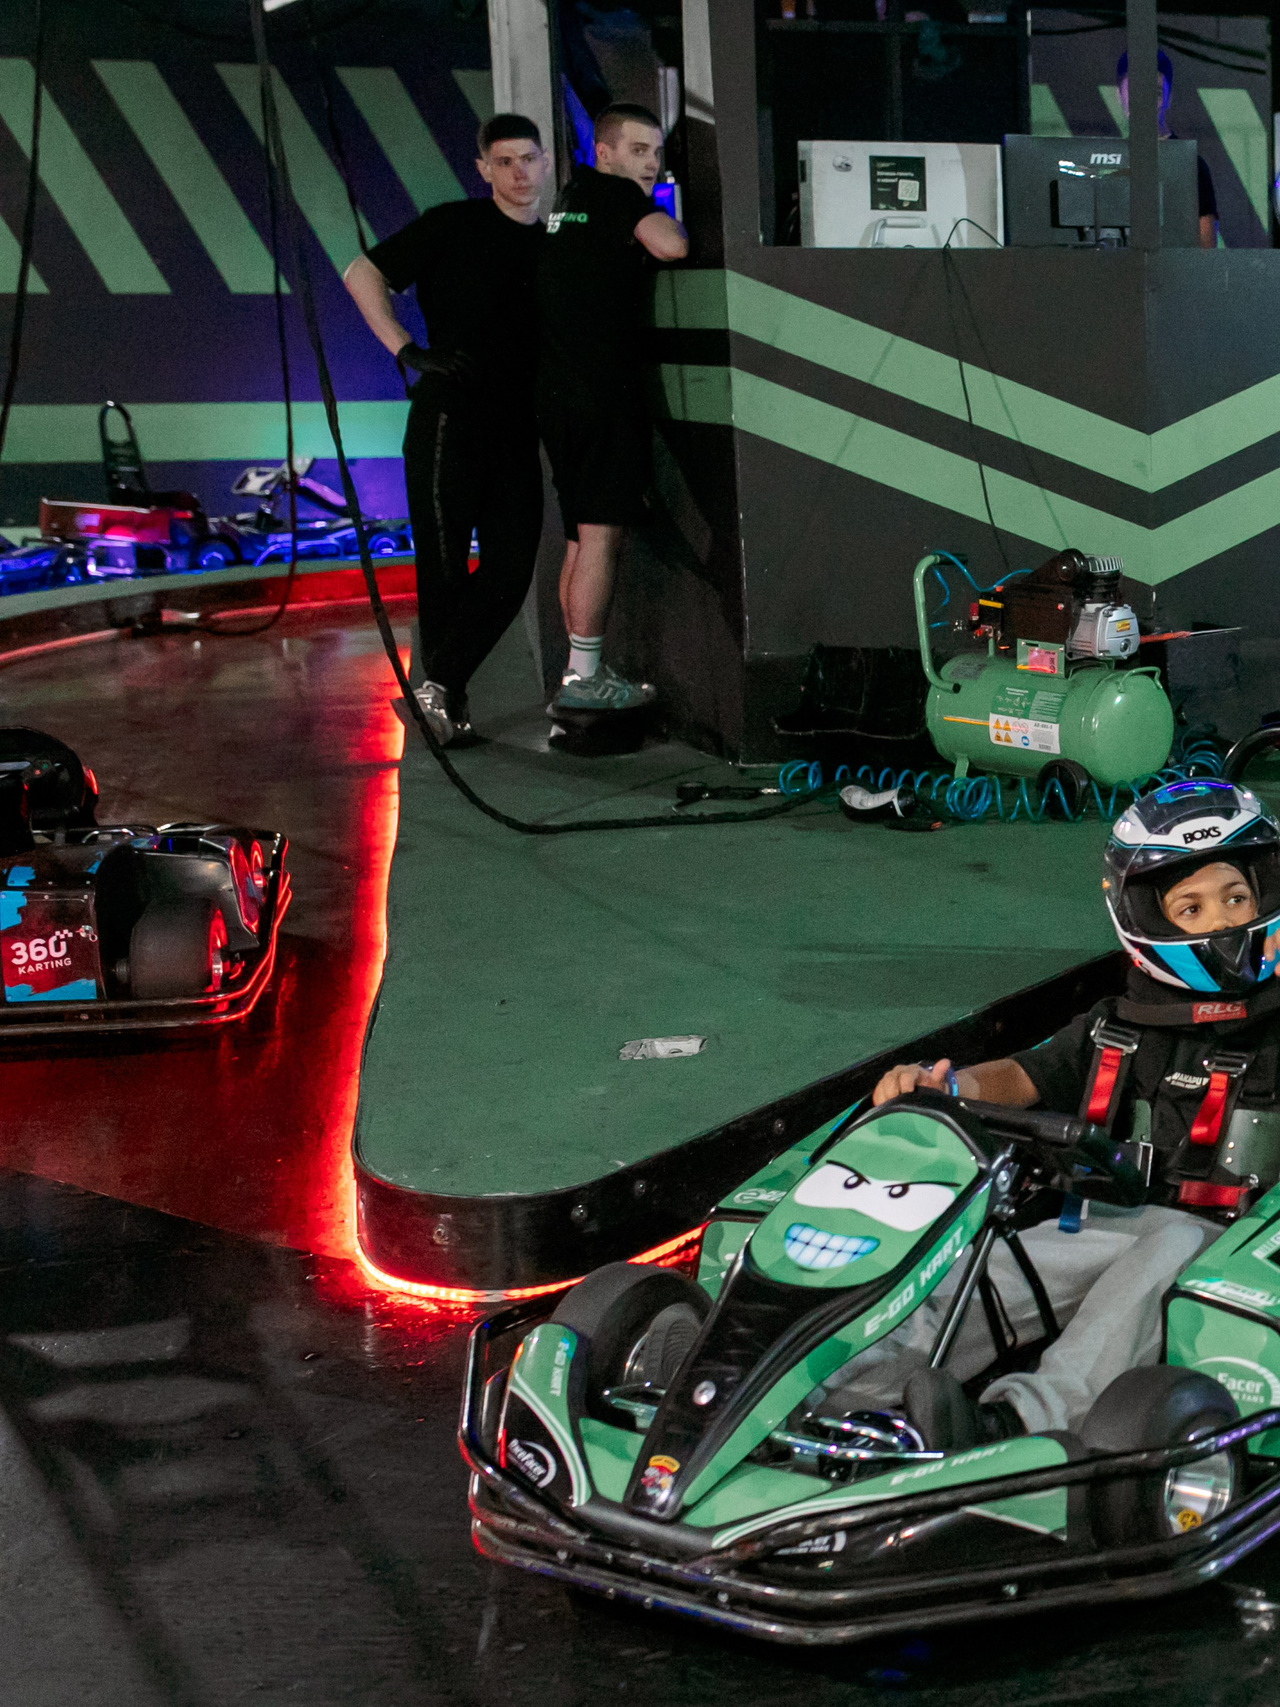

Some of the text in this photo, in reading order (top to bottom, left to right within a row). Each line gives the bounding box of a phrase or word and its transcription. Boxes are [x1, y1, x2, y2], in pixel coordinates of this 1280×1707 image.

[1090, 153, 1122, 165] msi
[10, 935, 68, 965] 360
[18, 957, 72, 975] KARTING
[919, 1226, 964, 1288] KART
